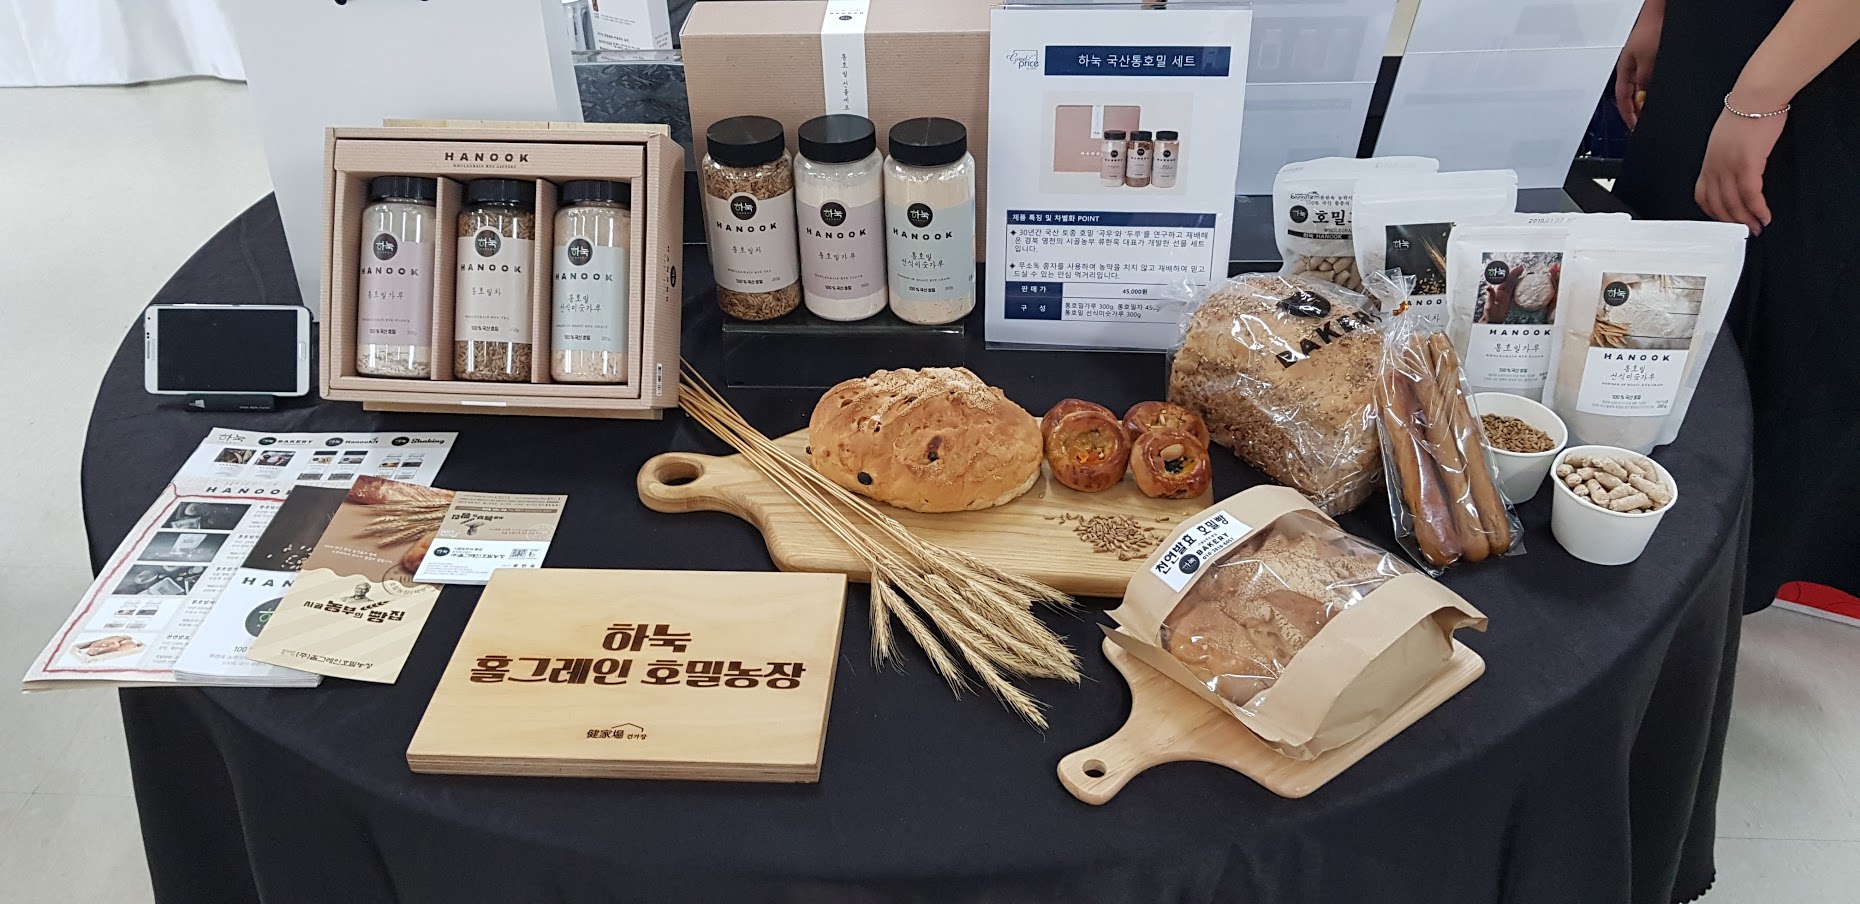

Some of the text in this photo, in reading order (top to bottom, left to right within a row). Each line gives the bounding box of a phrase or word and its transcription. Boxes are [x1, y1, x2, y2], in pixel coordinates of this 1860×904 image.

[1018, 61, 1039, 69] price
[1078, 54, 1196, 68] 하눅 국산통호밀 세트
[444, 152, 529, 163] HANOOK
[733, 202, 754, 212] 하눅
[823, 208, 843, 218] 하눅
[910, 209, 930, 220] 하눅
[1312, 209, 1352, 226] 호밀
[716, 221, 777, 233] HANOOK
[806, 227, 866, 239] HANOOK
[893, 227, 953, 241] HANOOK
[1044, 229, 1059, 237] 국산
[375, 240, 395, 252] 하눅
[478, 238, 498, 249] 하눅
[1393, 239, 1410, 249] 하눅
[570, 246, 589, 257] 하눅
[361, 267, 419, 276] HANOOK
[460, 264, 522, 273] HANOOK
[1067, 263, 1096, 271] 사용하여
[1487, 266, 1507, 277] 하눅
[555, 272, 613, 281] HANOOK
[1013, 270, 1028, 278] 드실
[1607, 287, 1627, 299] 하눅
[1604, 353, 1670, 362] HANOOK
[1155, 534, 1198, 575] 천연발효
[1196, 514, 1229, 536] 호밀빵
[1196, 532, 1230, 556] BAKERY
[303, 600, 406, 624] 시골 농부의 빵집
[602, 623, 692, 653] 하눅
[469, 654, 806, 690] 홀그레인 호밀농장
[586, 728, 624, 740] 健家場
